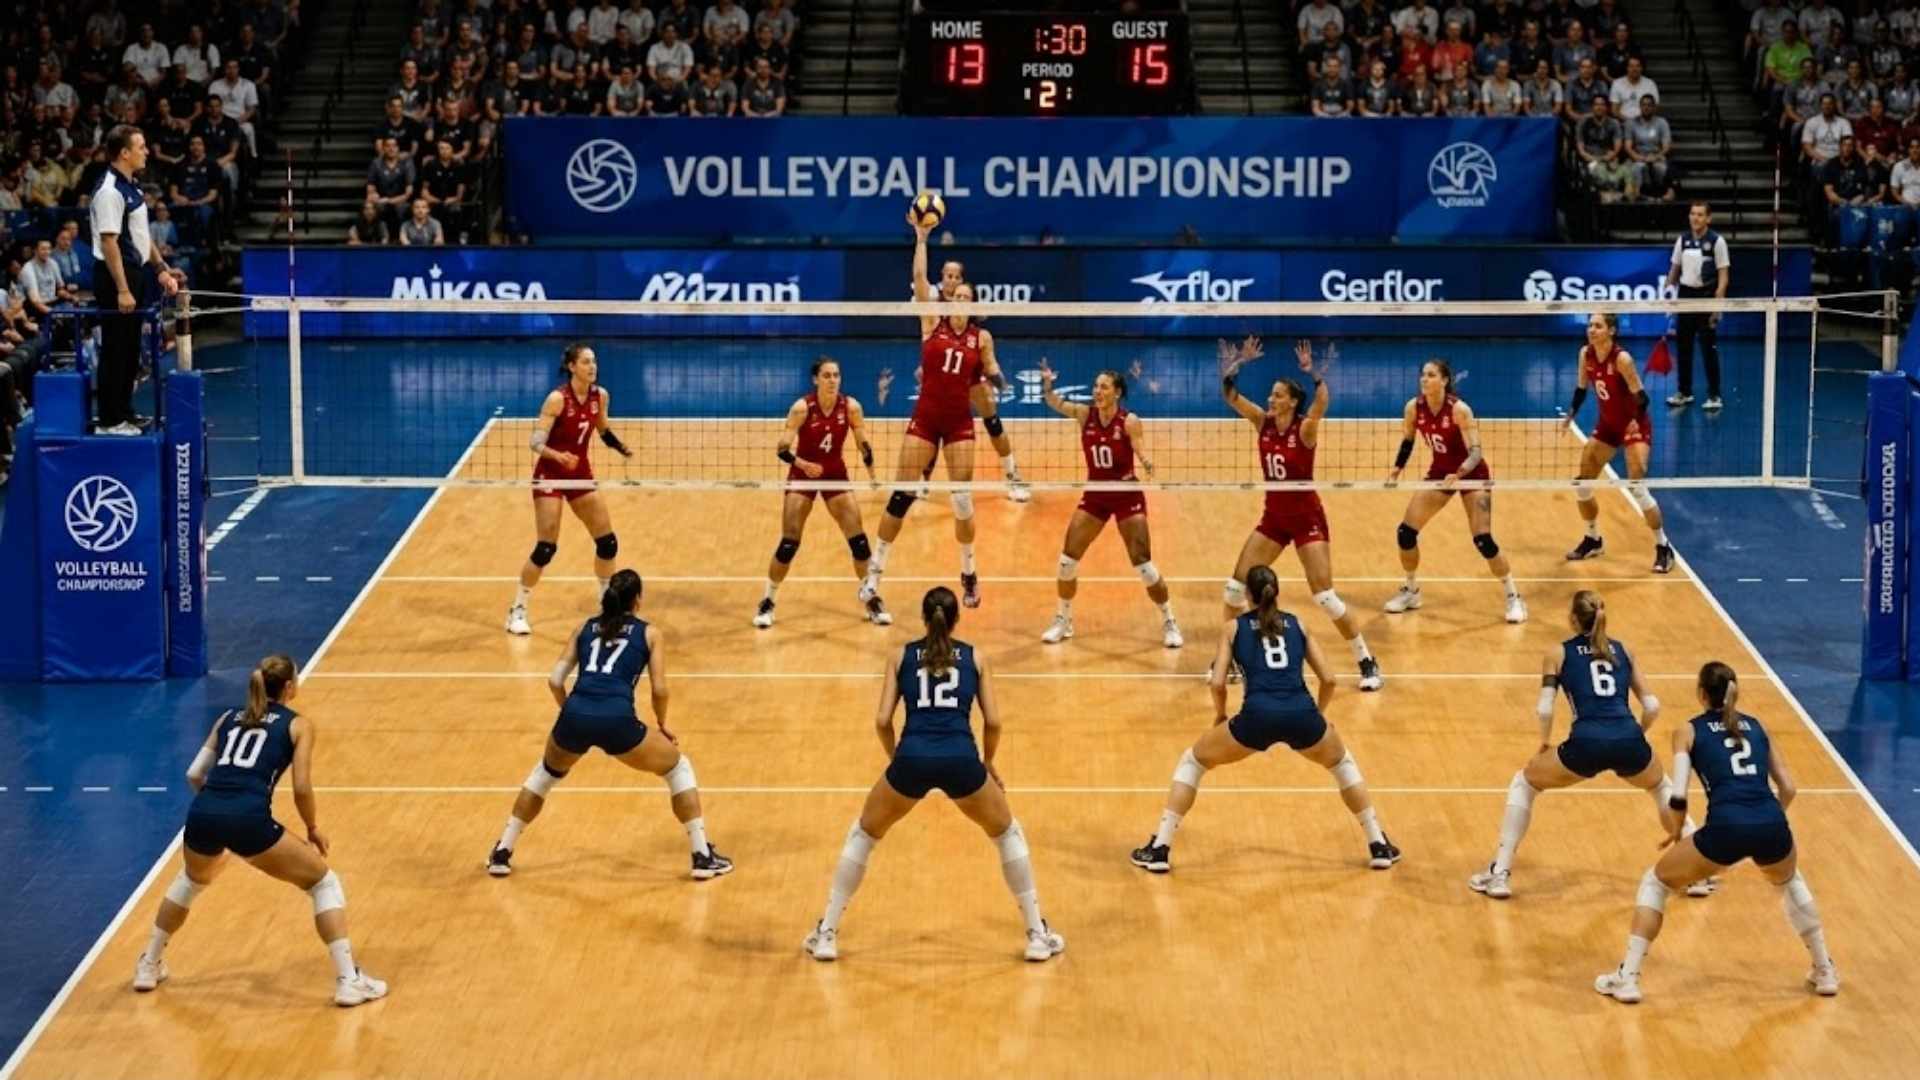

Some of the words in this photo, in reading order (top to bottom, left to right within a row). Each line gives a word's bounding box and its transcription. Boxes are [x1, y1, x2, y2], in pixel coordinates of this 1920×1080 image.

[932, 21, 983, 39] HOME
[1036, 24, 1087, 55] 1:30
[1112, 21, 1168, 39] GUEST
[948, 45, 984, 84] 13
[1022, 64, 1073, 77] PERIOD
[1133, 45, 1168, 84] 15
[1039, 81, 1057, 108] 2
[664, 157, 970, 197] VOLLEYBALL
[983, 156, 1351, 198] CHAMPIONSHIP
[942, 348, 964, 374] 11
[577, 421, 589, 445] 7
[819, 432, 832, 453] 4
[1090, 444, 1113, 469] 10
[1265, 452, 1287, 480] 16
[55, 561, 147, 576] VOLLEYBALL
[585, 638, 629, 674] 17
[1262, 635, 1289, 669] 8
[916, 666, 959, 708] 12
[1590, 659, 1617, 697] 6
[217, 727, 268, 769] 10
[1723, 738, 1757, 775] 2
